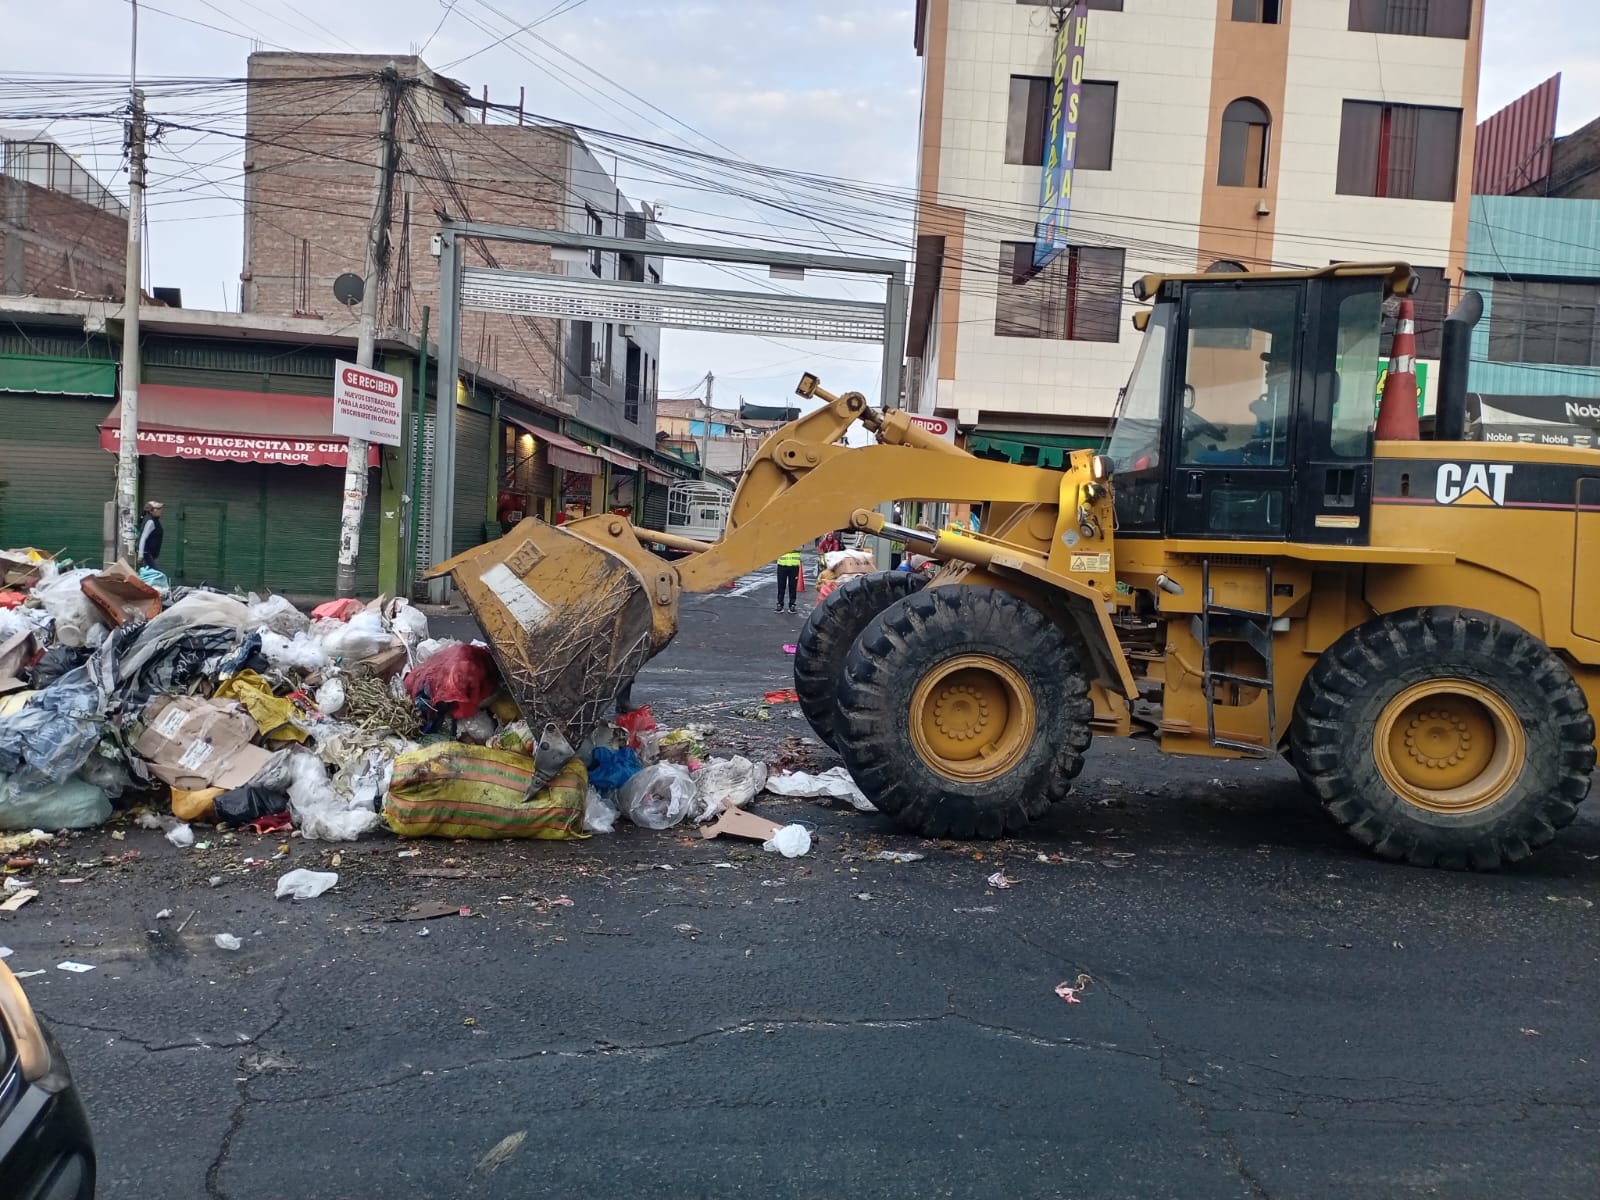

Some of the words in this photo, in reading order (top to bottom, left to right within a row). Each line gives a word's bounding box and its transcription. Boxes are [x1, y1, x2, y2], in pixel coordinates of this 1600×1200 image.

[1044, 19, 1070, 203] HOSTAL
[1060, 16, 1087, 236] HOSTAL
[347, 372, 358, 385] SE
[359, 375, 394, 395] RECIBEN
[337, 397, 352, 407] PARA
[352, 401, 359, 409] LA
[1565, 402, 1600, 417] Nob
[112, 429, 185, 444] TMATES
[294, 442, 316, 452] DE
[1486, 432, 1513, 442] Noble
[1541, 434, 1569, 445] Noble
[176, 446, 202, 455] POR
[205, 448, 248, 458] MAYOR
[252, 451, 261, 459] Y
[263, 452, 309, 461] MENOR
[1436, 463, 1513, 506] CAT
